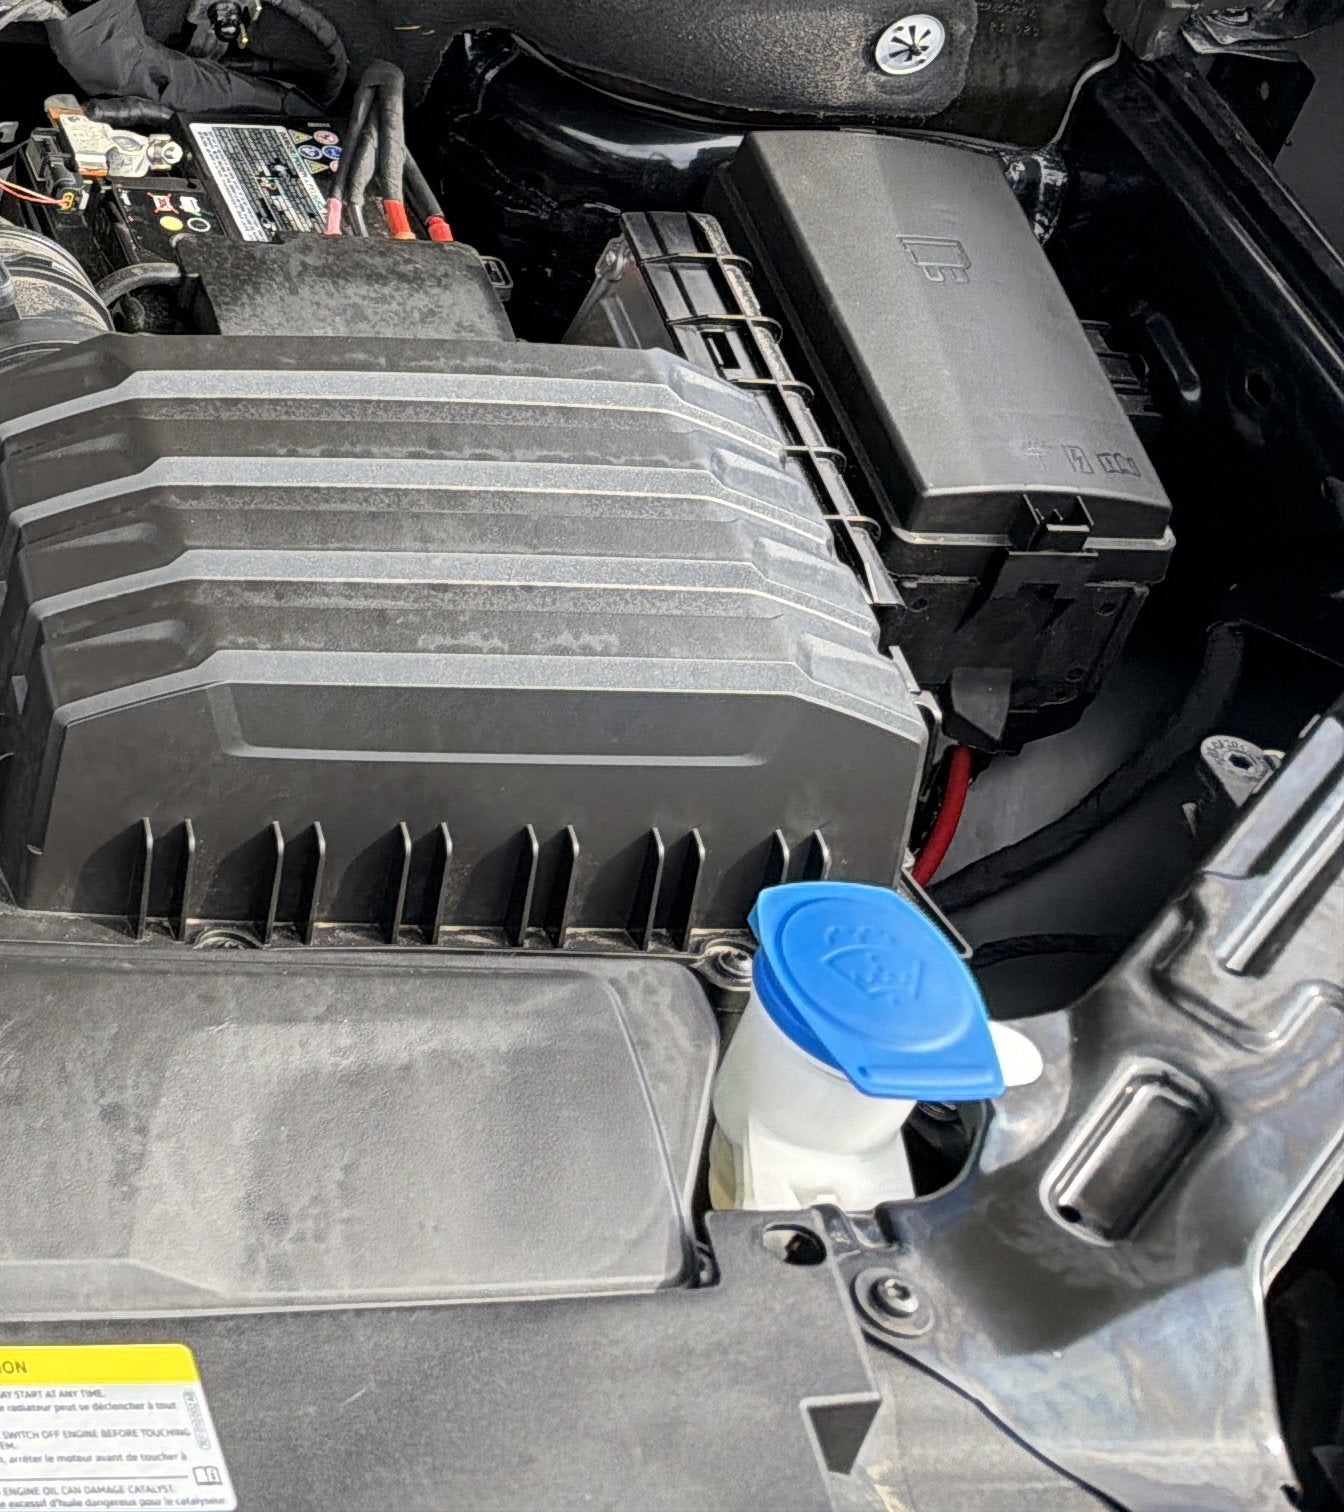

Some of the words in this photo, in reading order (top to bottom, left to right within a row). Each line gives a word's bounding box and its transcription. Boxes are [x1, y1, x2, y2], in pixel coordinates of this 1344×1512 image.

[14, 1390, 43, 1399] START
[59, 1390, 79, 1398] ANY
[7, 1403, 51, 1412] radiateur
[2, 1431, 39, 1440] SWITCH
[41, 1430, 60, 1439] OFF
[101, 1429, 139, 1438] BEFORE
[140, 1428, 191, 1437] TOUCHING
[57, 1454, 92, 1462] moteur
[96, 1454, 123, 1462] avant
[140, 1452, 178, 1461] toucher
[3, 1487, 40, 1496] ENGINE
[43, 1487, 59, 1496] OIL
[61, 1486, 81, 1494] CAN
[84, 1485, 125, 1494] DAMAGE
